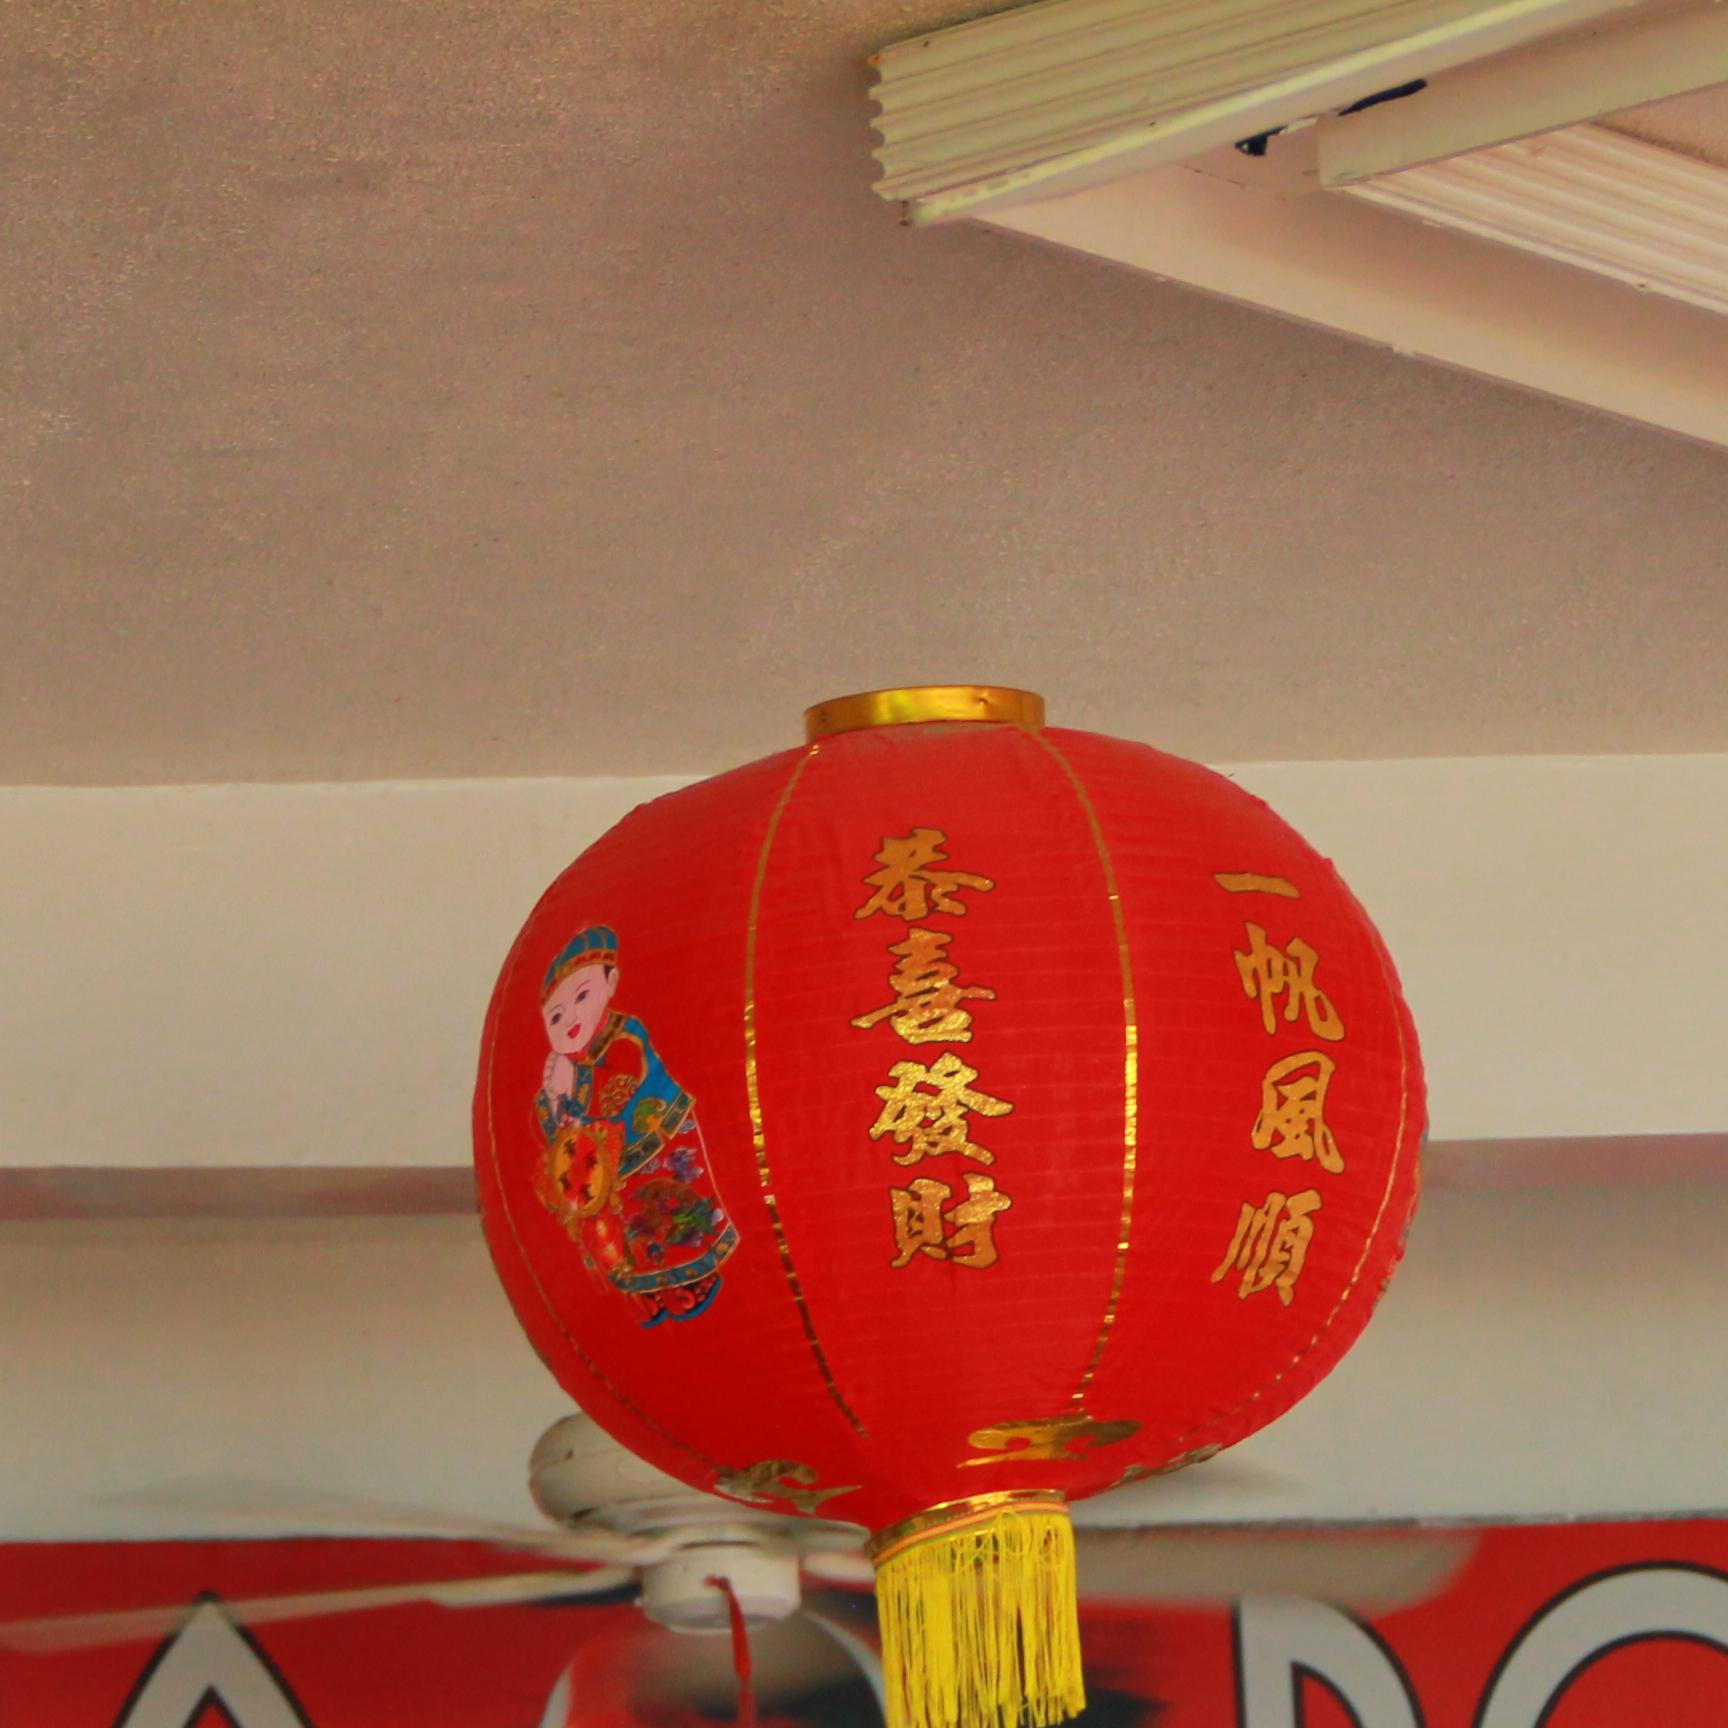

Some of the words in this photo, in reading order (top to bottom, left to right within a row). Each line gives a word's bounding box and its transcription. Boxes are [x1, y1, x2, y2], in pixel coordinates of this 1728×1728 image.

[851, 826, 1014, 1271] 恭喜發財
[1210, 870, 1346, 1308] 一帆風順
